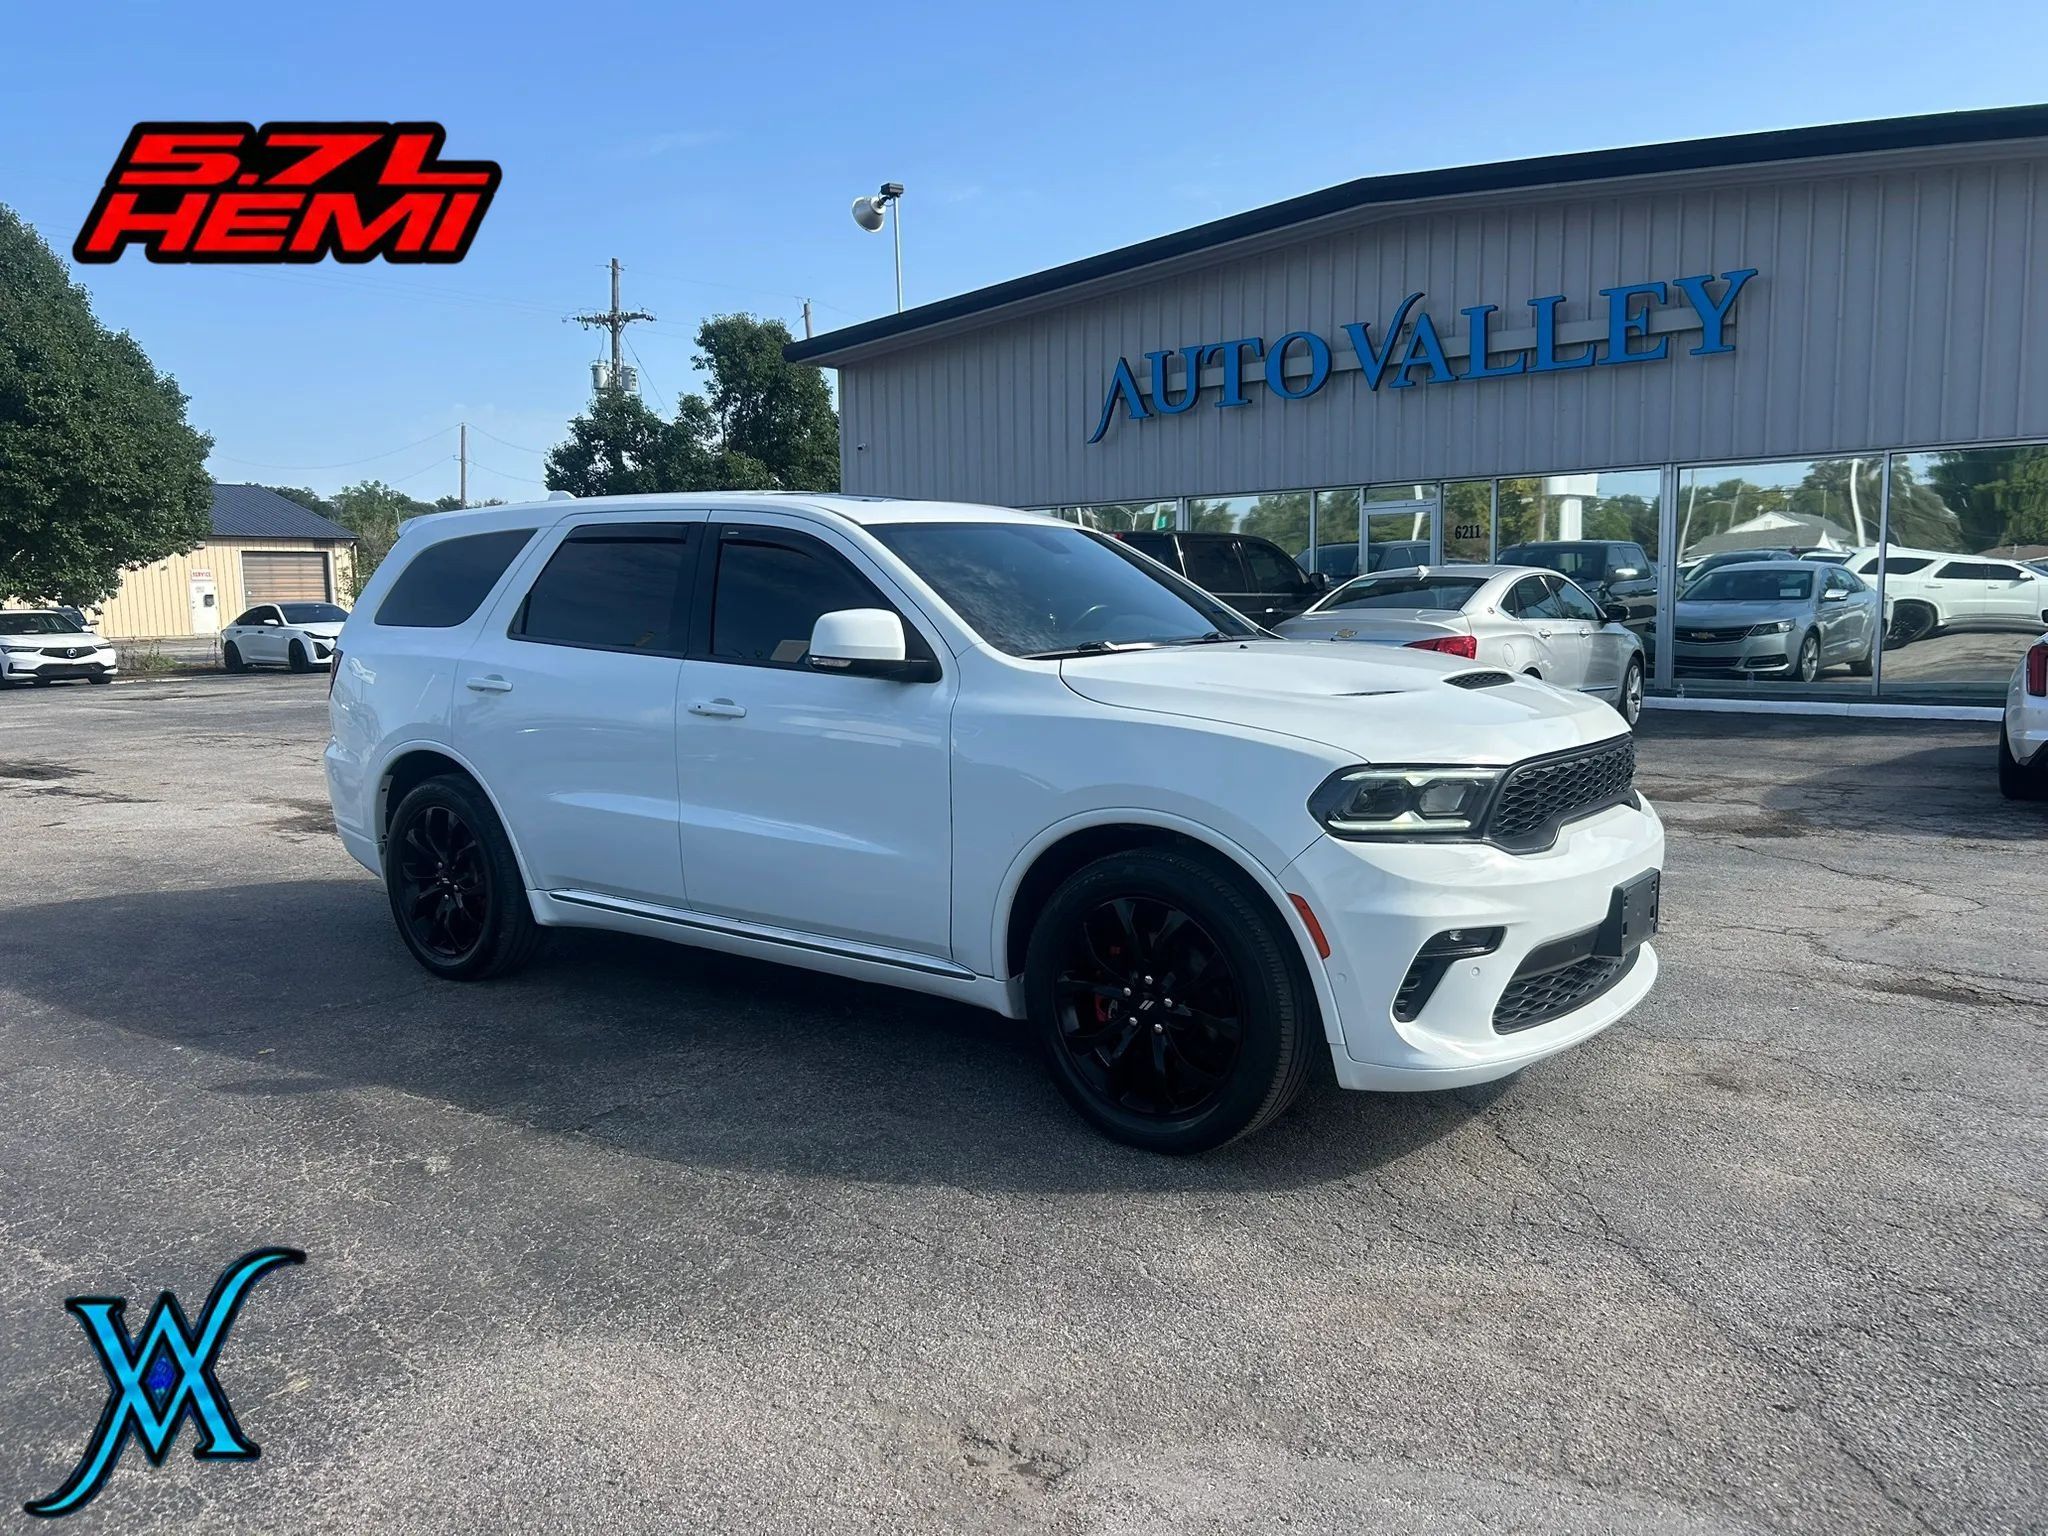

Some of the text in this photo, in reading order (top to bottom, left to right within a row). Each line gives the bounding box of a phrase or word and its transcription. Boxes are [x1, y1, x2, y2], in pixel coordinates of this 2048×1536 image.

[1087, 268, 1759, 443] AUTO VALLEY
[1454, 524, 1481, 540] 6211
